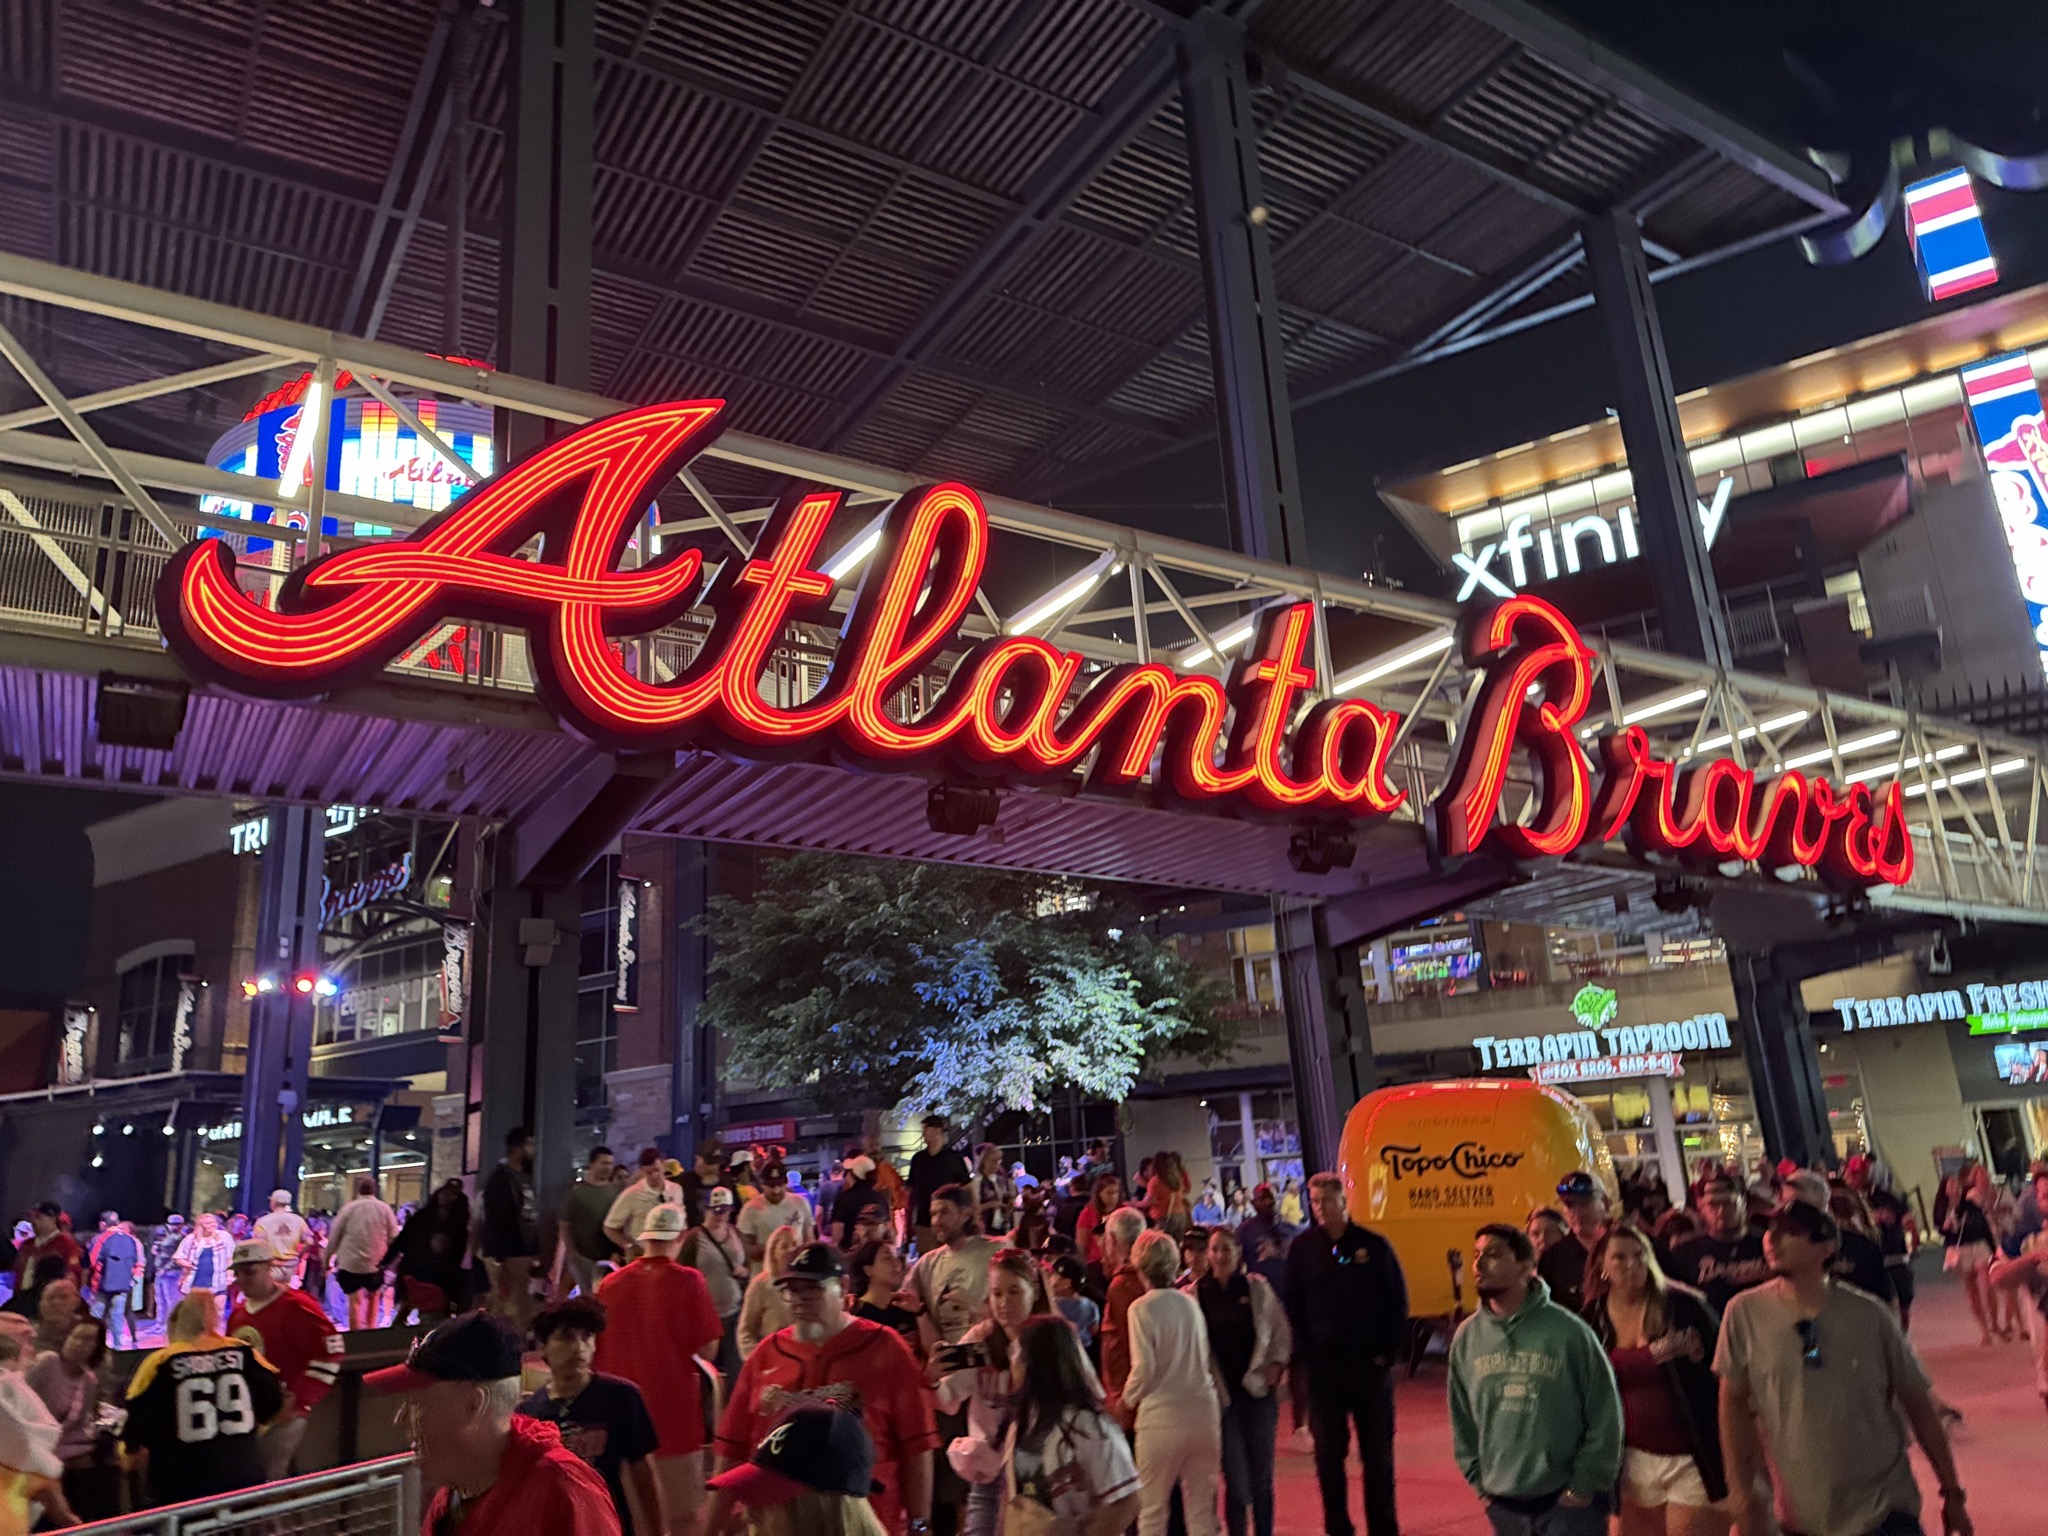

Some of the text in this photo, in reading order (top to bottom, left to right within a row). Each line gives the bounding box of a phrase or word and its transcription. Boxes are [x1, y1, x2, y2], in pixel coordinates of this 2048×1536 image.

[1452, 476, 1734, 602] xfiniy
[180, 399, 1913, 885] Atlanta Braves
[442, 922, 470, 1013] Braves
[1473, 1012, 1731, 1070] TERRAPIN TAPROOM
[1833, 990, 1966, 1031] TERRAPIN
[1380, 1141, 1525, 1180] Topo Chico
[176, 1372, 255, 1443] 69
